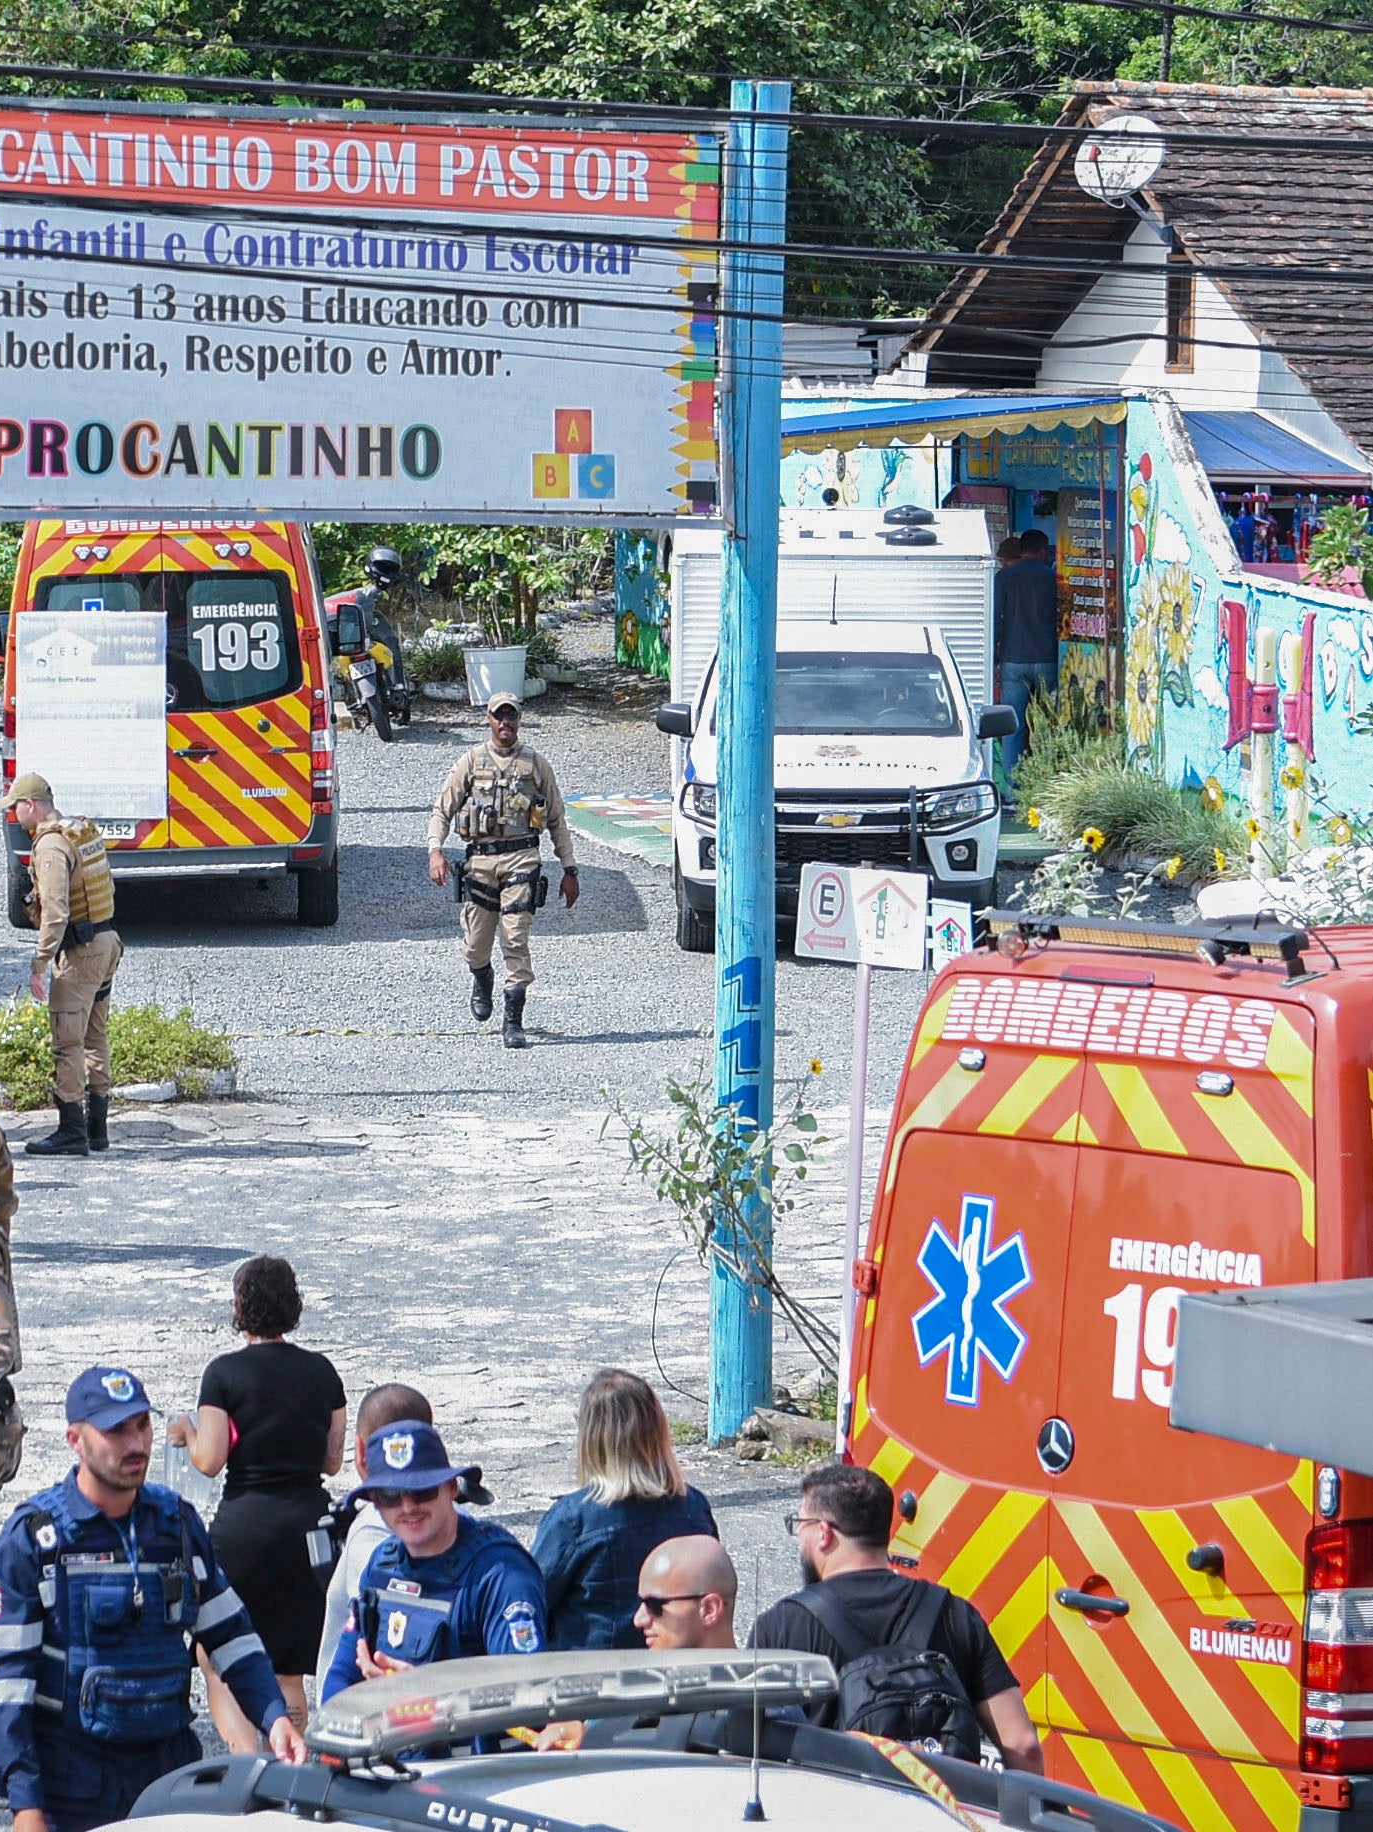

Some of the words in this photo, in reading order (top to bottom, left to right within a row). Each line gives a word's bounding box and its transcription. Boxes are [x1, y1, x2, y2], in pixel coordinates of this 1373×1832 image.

[294, 139, 416, 195] BOM
[439, 143, 649, 202] PASTOR
[164, 234, 187, 263] e
[203, 222, 468, 272] Contraturno
[485, 232, 640, 275] Escolar
[63, 281, 108, 319] de
[128, 284, 177, 321] 13
[193, 294, 286, 323] anos
[302, 287, 488, 328] Educando
[502, 299, 580, 328] com
[185, 335, 352, 381] Respeito
[366, 347, 387, 374] e
[400, 341, 512, 376] Amor.
[567, 418, 580, 443] A
[544, 465, 557, 487] B
[589, 465, 604, 488] C
[192, 602, 278, 619] EMERGÊNCIA
[192, 621, 281, 672] 193
[818, 884, 836, 916] E
[940, 977, 1276, 1069] BOMBEIROS
[1109, 1237, 1262, 1287] EMERGÊNCIA
[1103, 1283, 1188, 1408] 19
[1189, 1627, 1291, 1665] BLUMENAU
[427, 1801, 549, 1832] DUSTE
